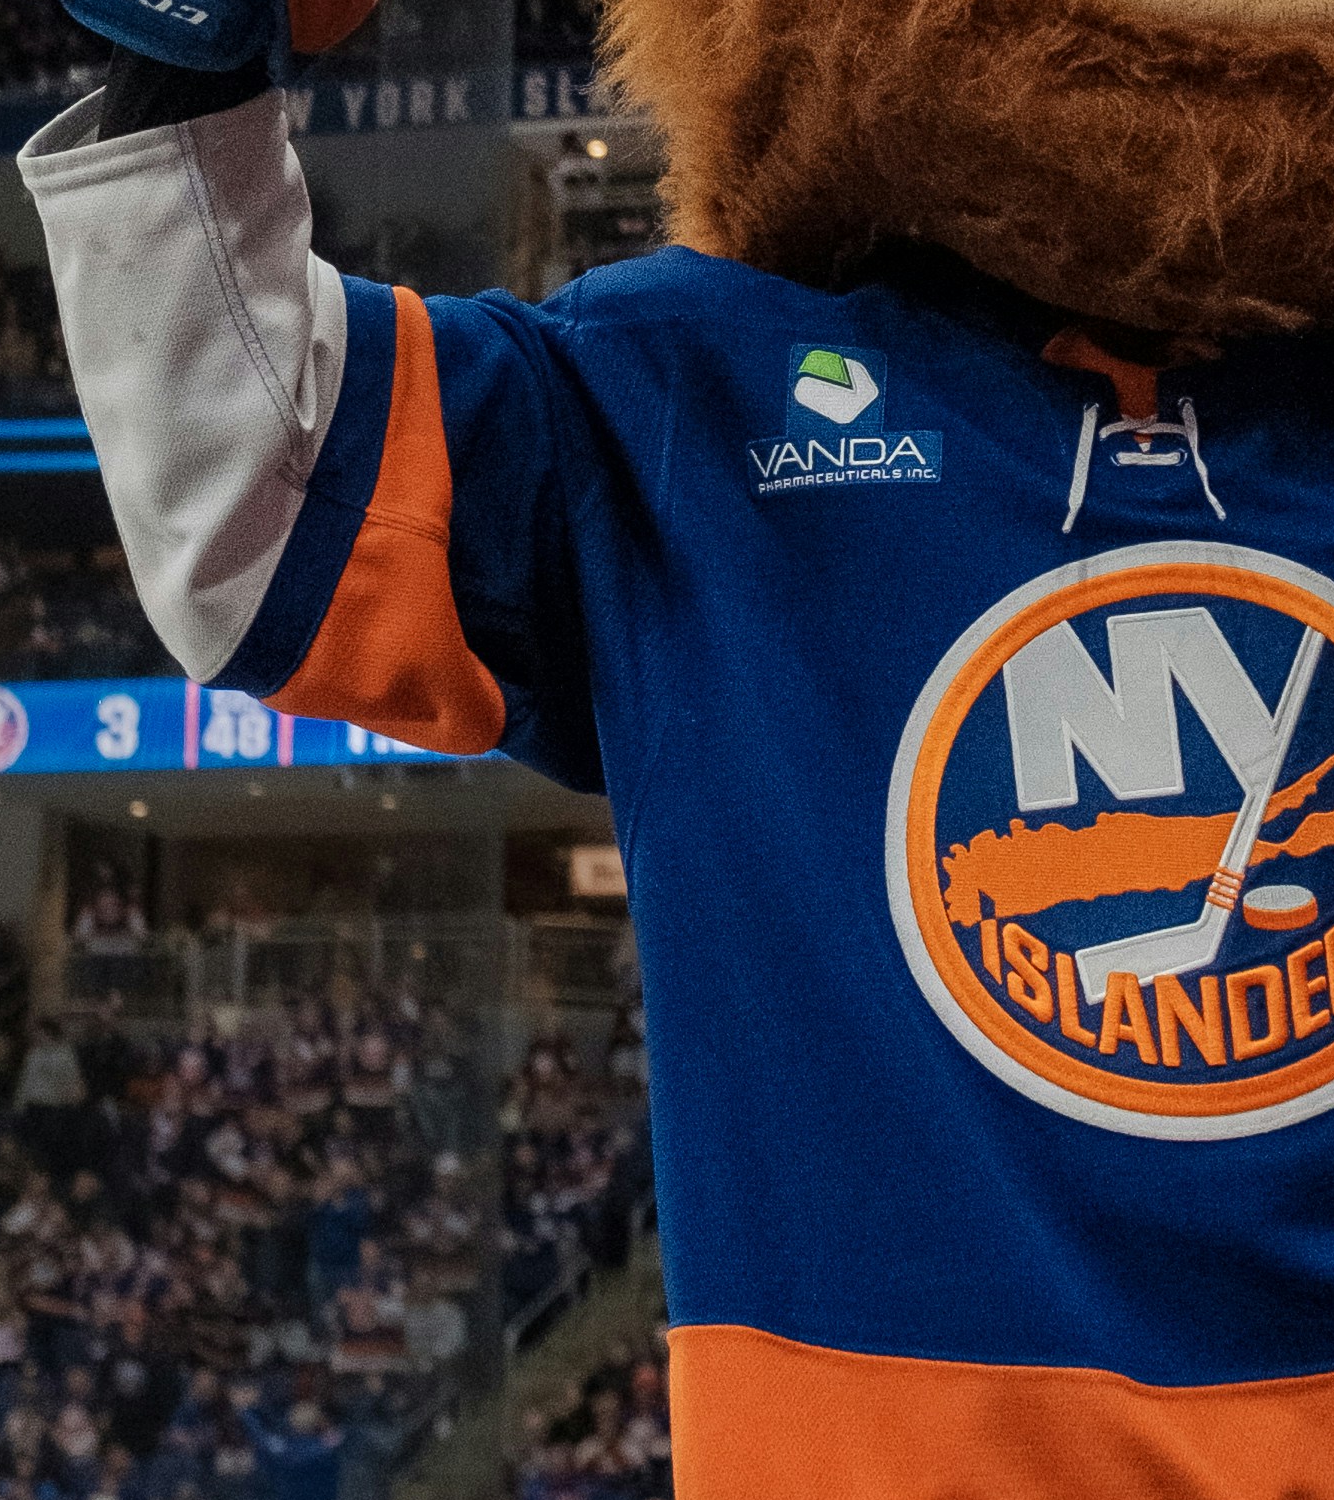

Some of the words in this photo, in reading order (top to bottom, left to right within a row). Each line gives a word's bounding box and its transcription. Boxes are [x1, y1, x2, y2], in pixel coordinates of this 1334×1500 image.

[341, 76, 471, 130] YORK
[749, 435, 927, 479] VANDA
[758, 467, 902, 494] PHARMACEUTICALS
[95, 693, 141, 761] 3
[1002, 606, 1327, 811] NY
